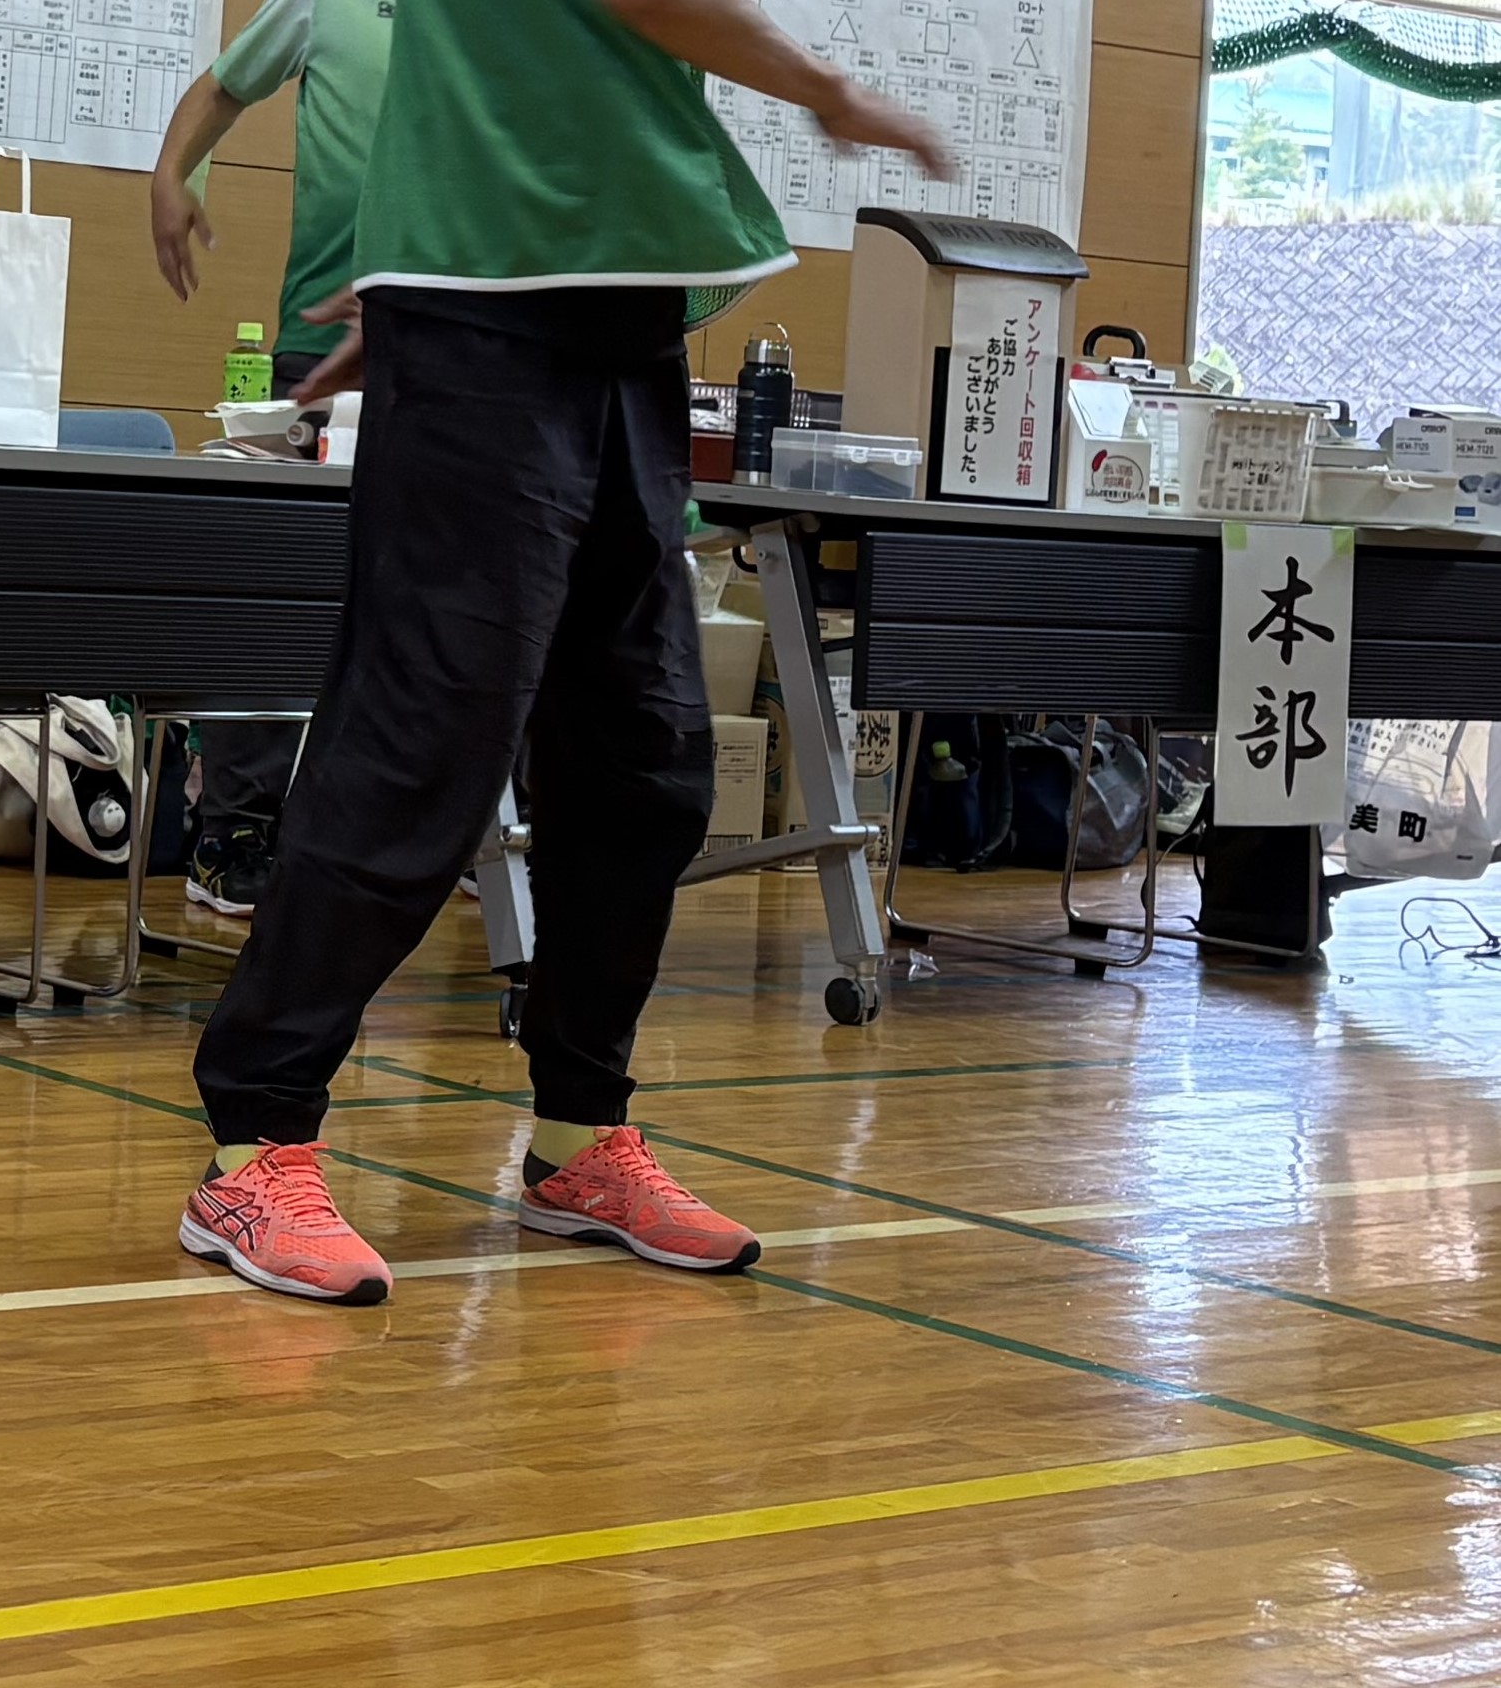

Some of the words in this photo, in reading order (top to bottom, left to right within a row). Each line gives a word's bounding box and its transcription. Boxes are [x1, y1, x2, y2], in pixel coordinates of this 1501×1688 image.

[982, 337, 1002, 435] ありがとう
[1002, 318, 1018, 377] ご協力
[1016, 298, 1042, 487] アンケート回収箱
[960, 355, 985, 484] ございました。
[1396, 442, 1430, 451] HEM-7120
[1456, 444, 1495, 455] HEM-7120
[1235, 556, 1335, 798] 本部
